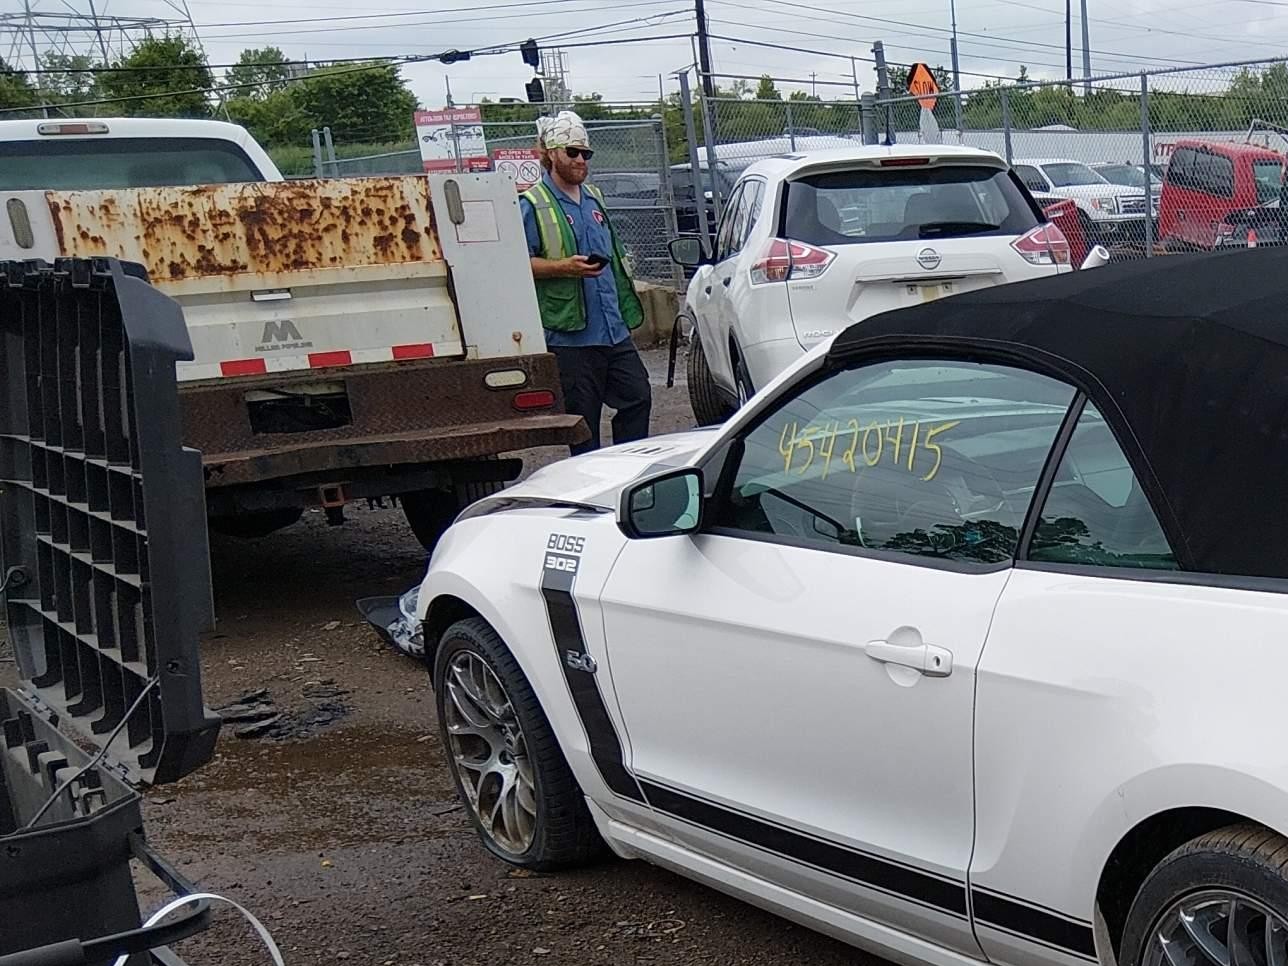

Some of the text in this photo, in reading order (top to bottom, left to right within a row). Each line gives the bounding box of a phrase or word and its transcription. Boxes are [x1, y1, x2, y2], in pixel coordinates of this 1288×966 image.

[778, 416, 961, 481] 45420415
[547, 533, 586, 553] BOSS
[545, 556, 577, 573] 302
